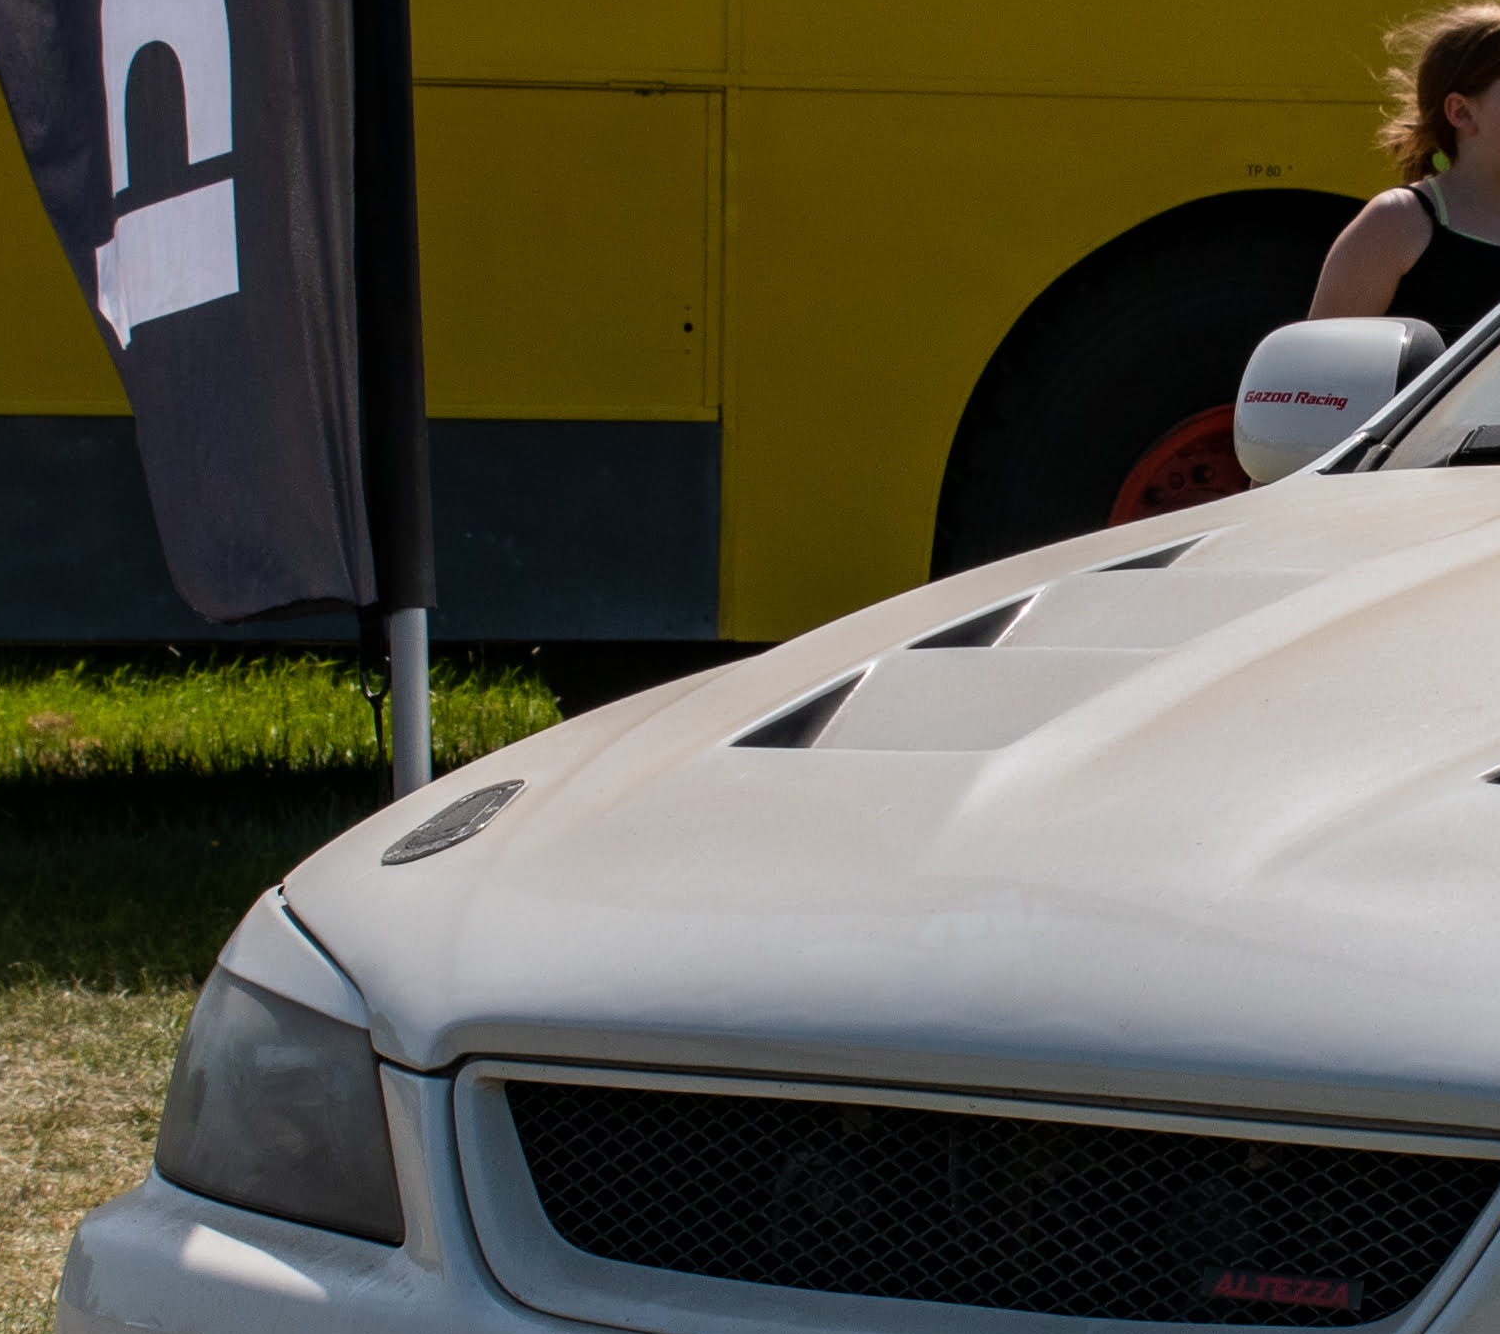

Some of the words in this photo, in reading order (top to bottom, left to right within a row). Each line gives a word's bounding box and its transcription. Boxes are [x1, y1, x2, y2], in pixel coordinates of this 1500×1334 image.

[1244, 389, 1292, 404] GAZOO
[1294, 390, 1349, 411] Racing
[1212, 1272, 1349, 1309] ALTEZZA
